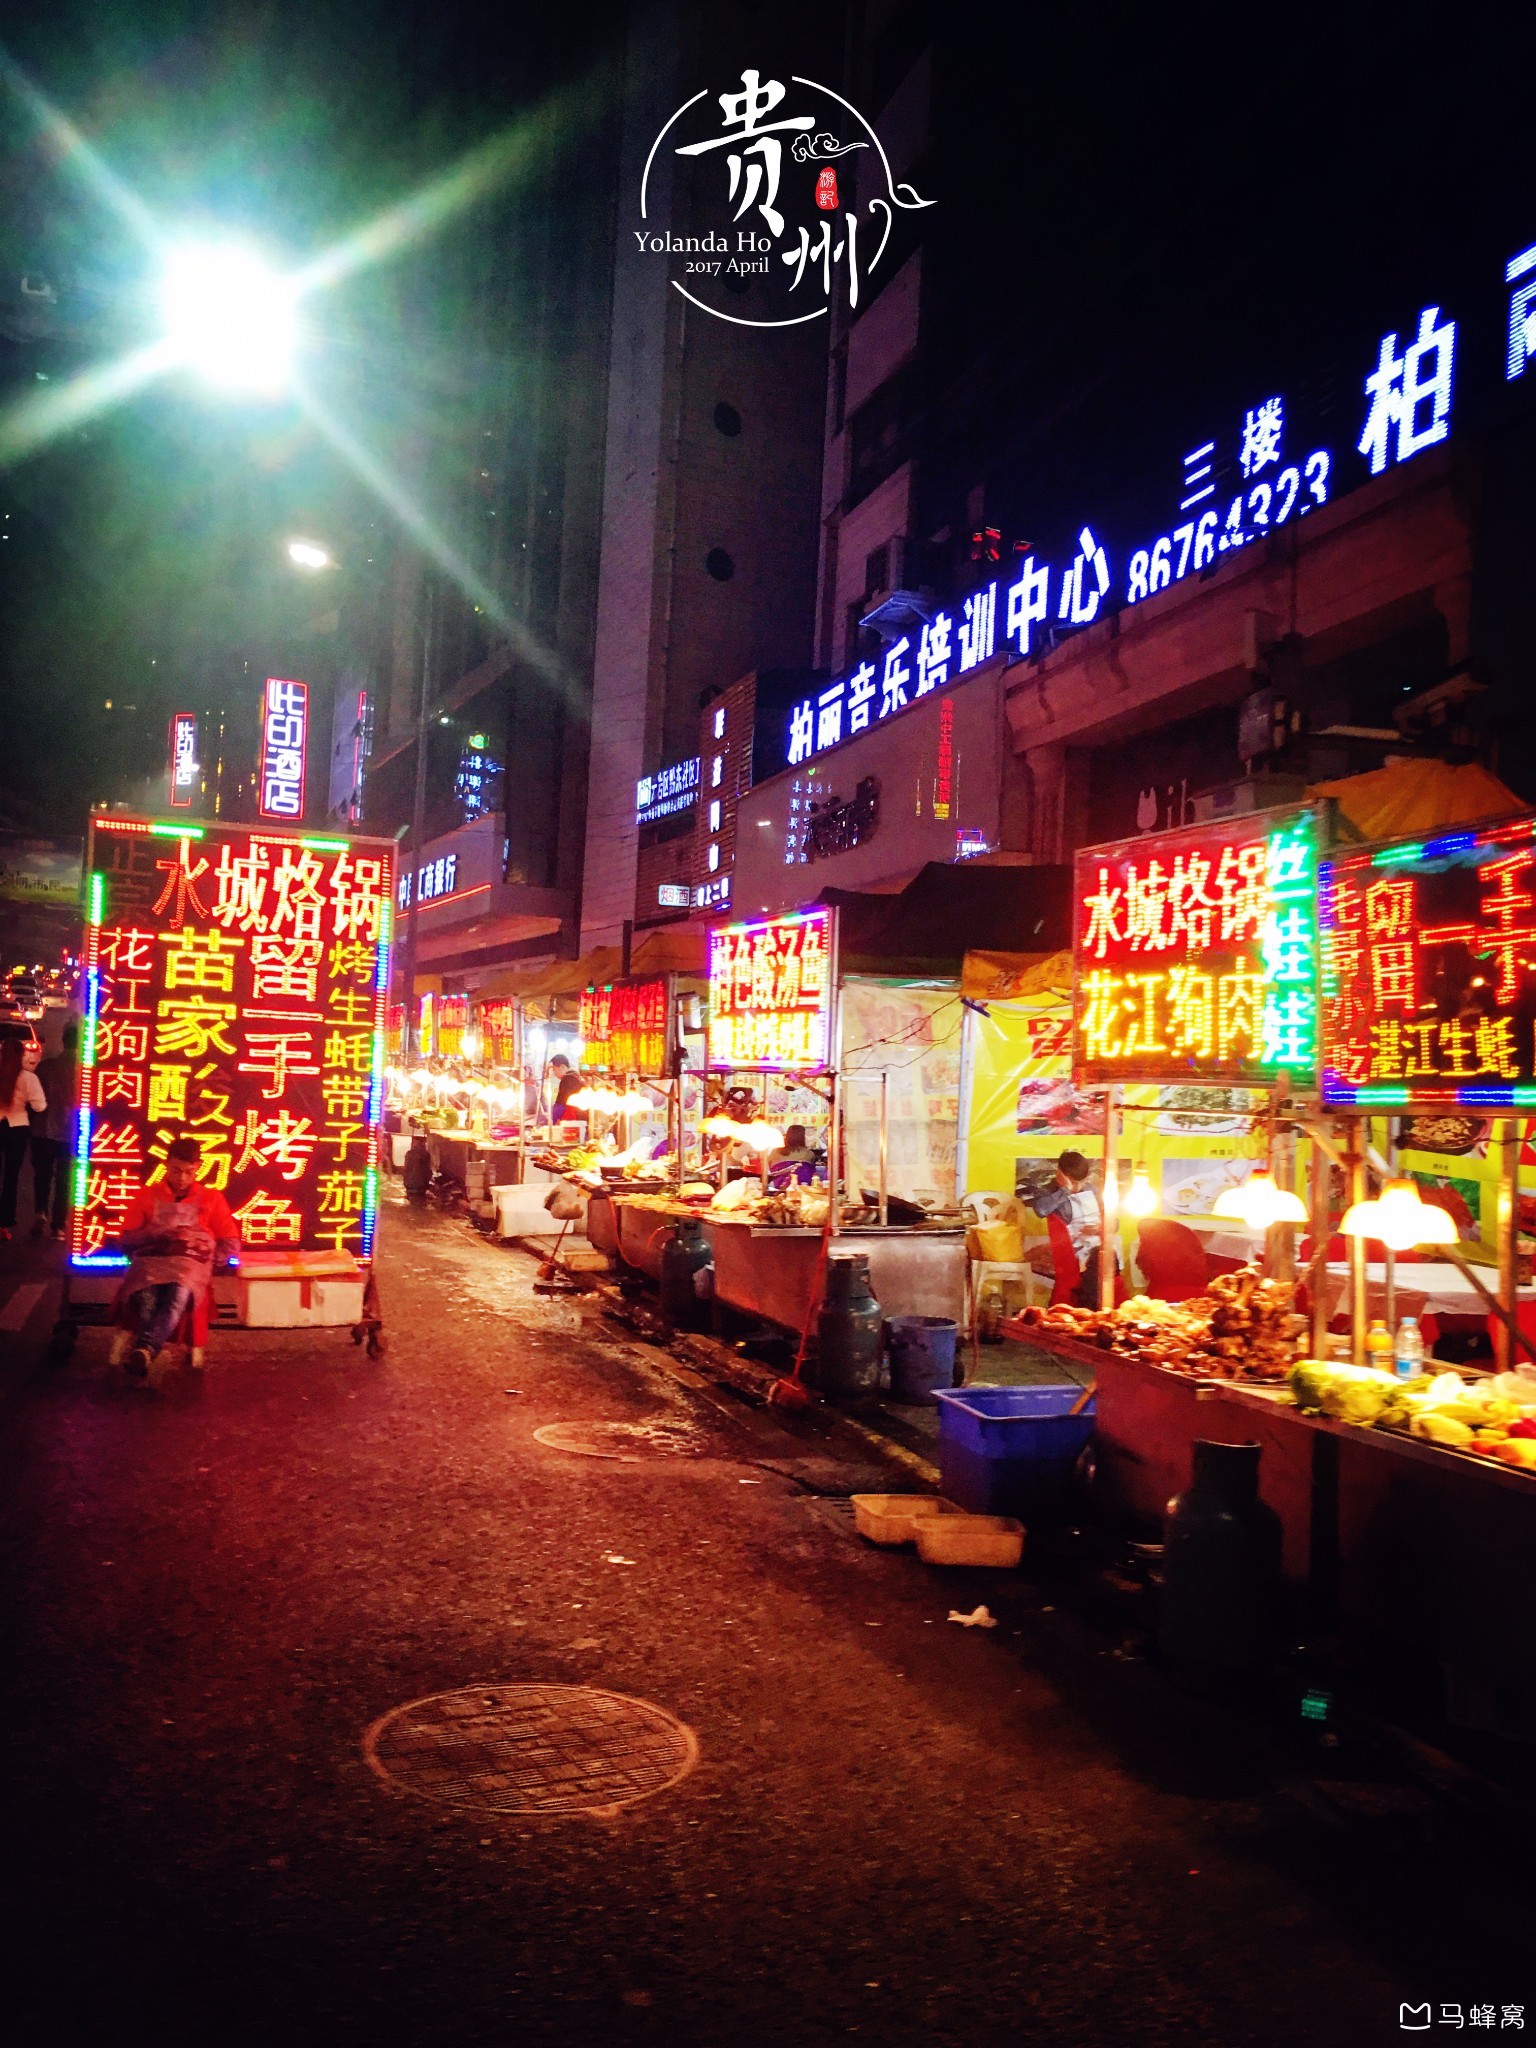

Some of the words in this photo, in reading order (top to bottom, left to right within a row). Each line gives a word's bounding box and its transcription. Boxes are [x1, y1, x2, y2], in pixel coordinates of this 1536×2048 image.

[1127, 450, 1331, 604] 86764323
[1180, 397, 1283, 510] 三楼
[787, 527, 1110, 765] 柏丽音乐培训中心
[153, 836, 382, 942] 水城烙锅
[661, 887, 690, 905] 烟酒
[1083, 847, 1267, 958] 水城烙锅
[1262, 829, 1313, 1063] 丝娃娃
[96, 927, 156, 1109] 花江狗肉
[1080, 956, 1266, 1061] 花江狗肉
[232, 934, 324, 1244] 留一手烤鱼
[315, 940, 379, 1252] 烤生蚝带子茄子
